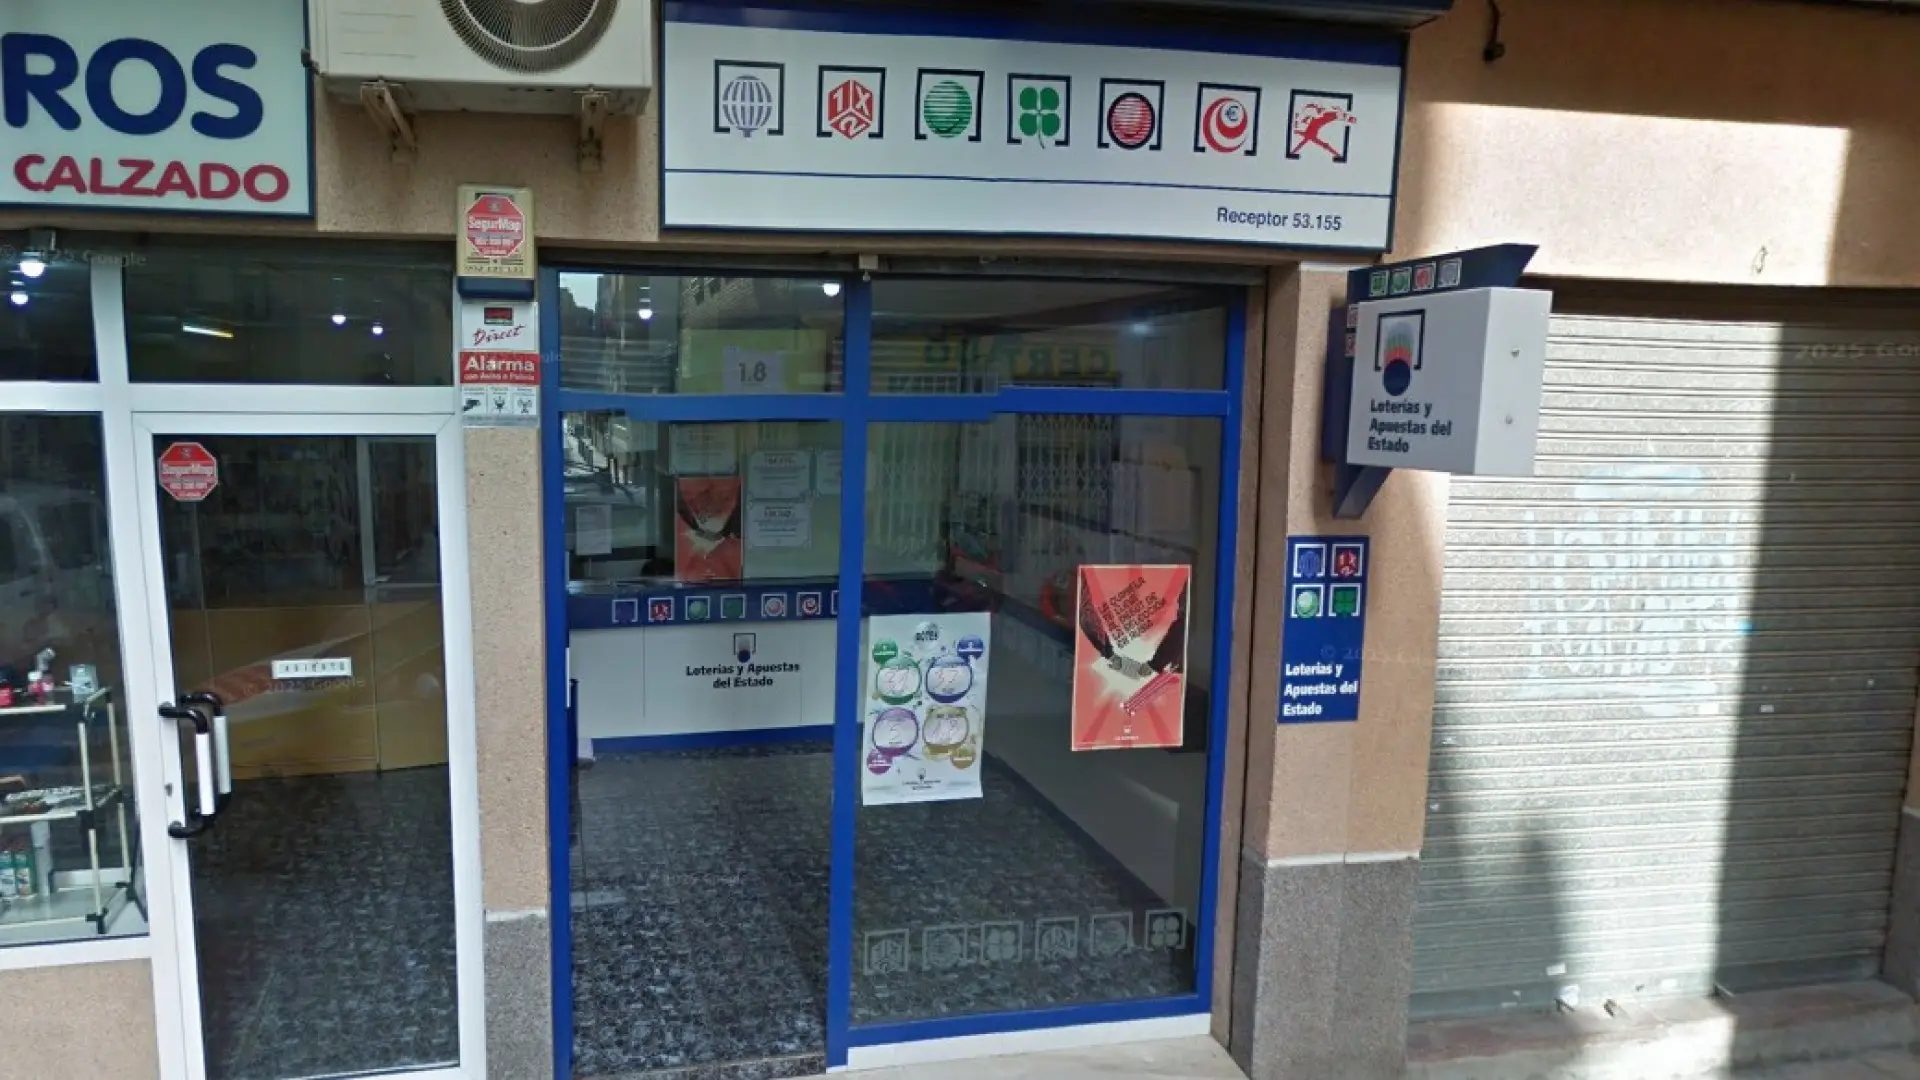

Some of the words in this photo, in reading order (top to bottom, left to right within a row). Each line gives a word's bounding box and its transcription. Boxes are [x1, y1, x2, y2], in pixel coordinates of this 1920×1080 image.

[2, 32, 264, 139] ROS
[13, 154, 289, 202] CALZADO
[1217, 206, 1288, 228] Receptor
[1292, 212, 1342, 231] 53.155
[464, 354, 535, 372] Alarma
[739, 361, 767, 382] 1.8
[1424, 403, 1432, 418] y
[1369, 418, 1427, 435] Apuestas
[1431, 420, 1452, 436] del
[1368, 437, 1409, 453] Estado
[737, 665, 744, 676] y
[748, 661, 800, 675] Apuestas
[1335, 663, 1343, 678] y
[713, 677, 731, 688] del
[733, 676, 773, 688] Estado
[1284, 682, 1337, 698] Apuestas
[1339, 680, 1359, 693] del
[1283, 701, 1322, 717] Estado
